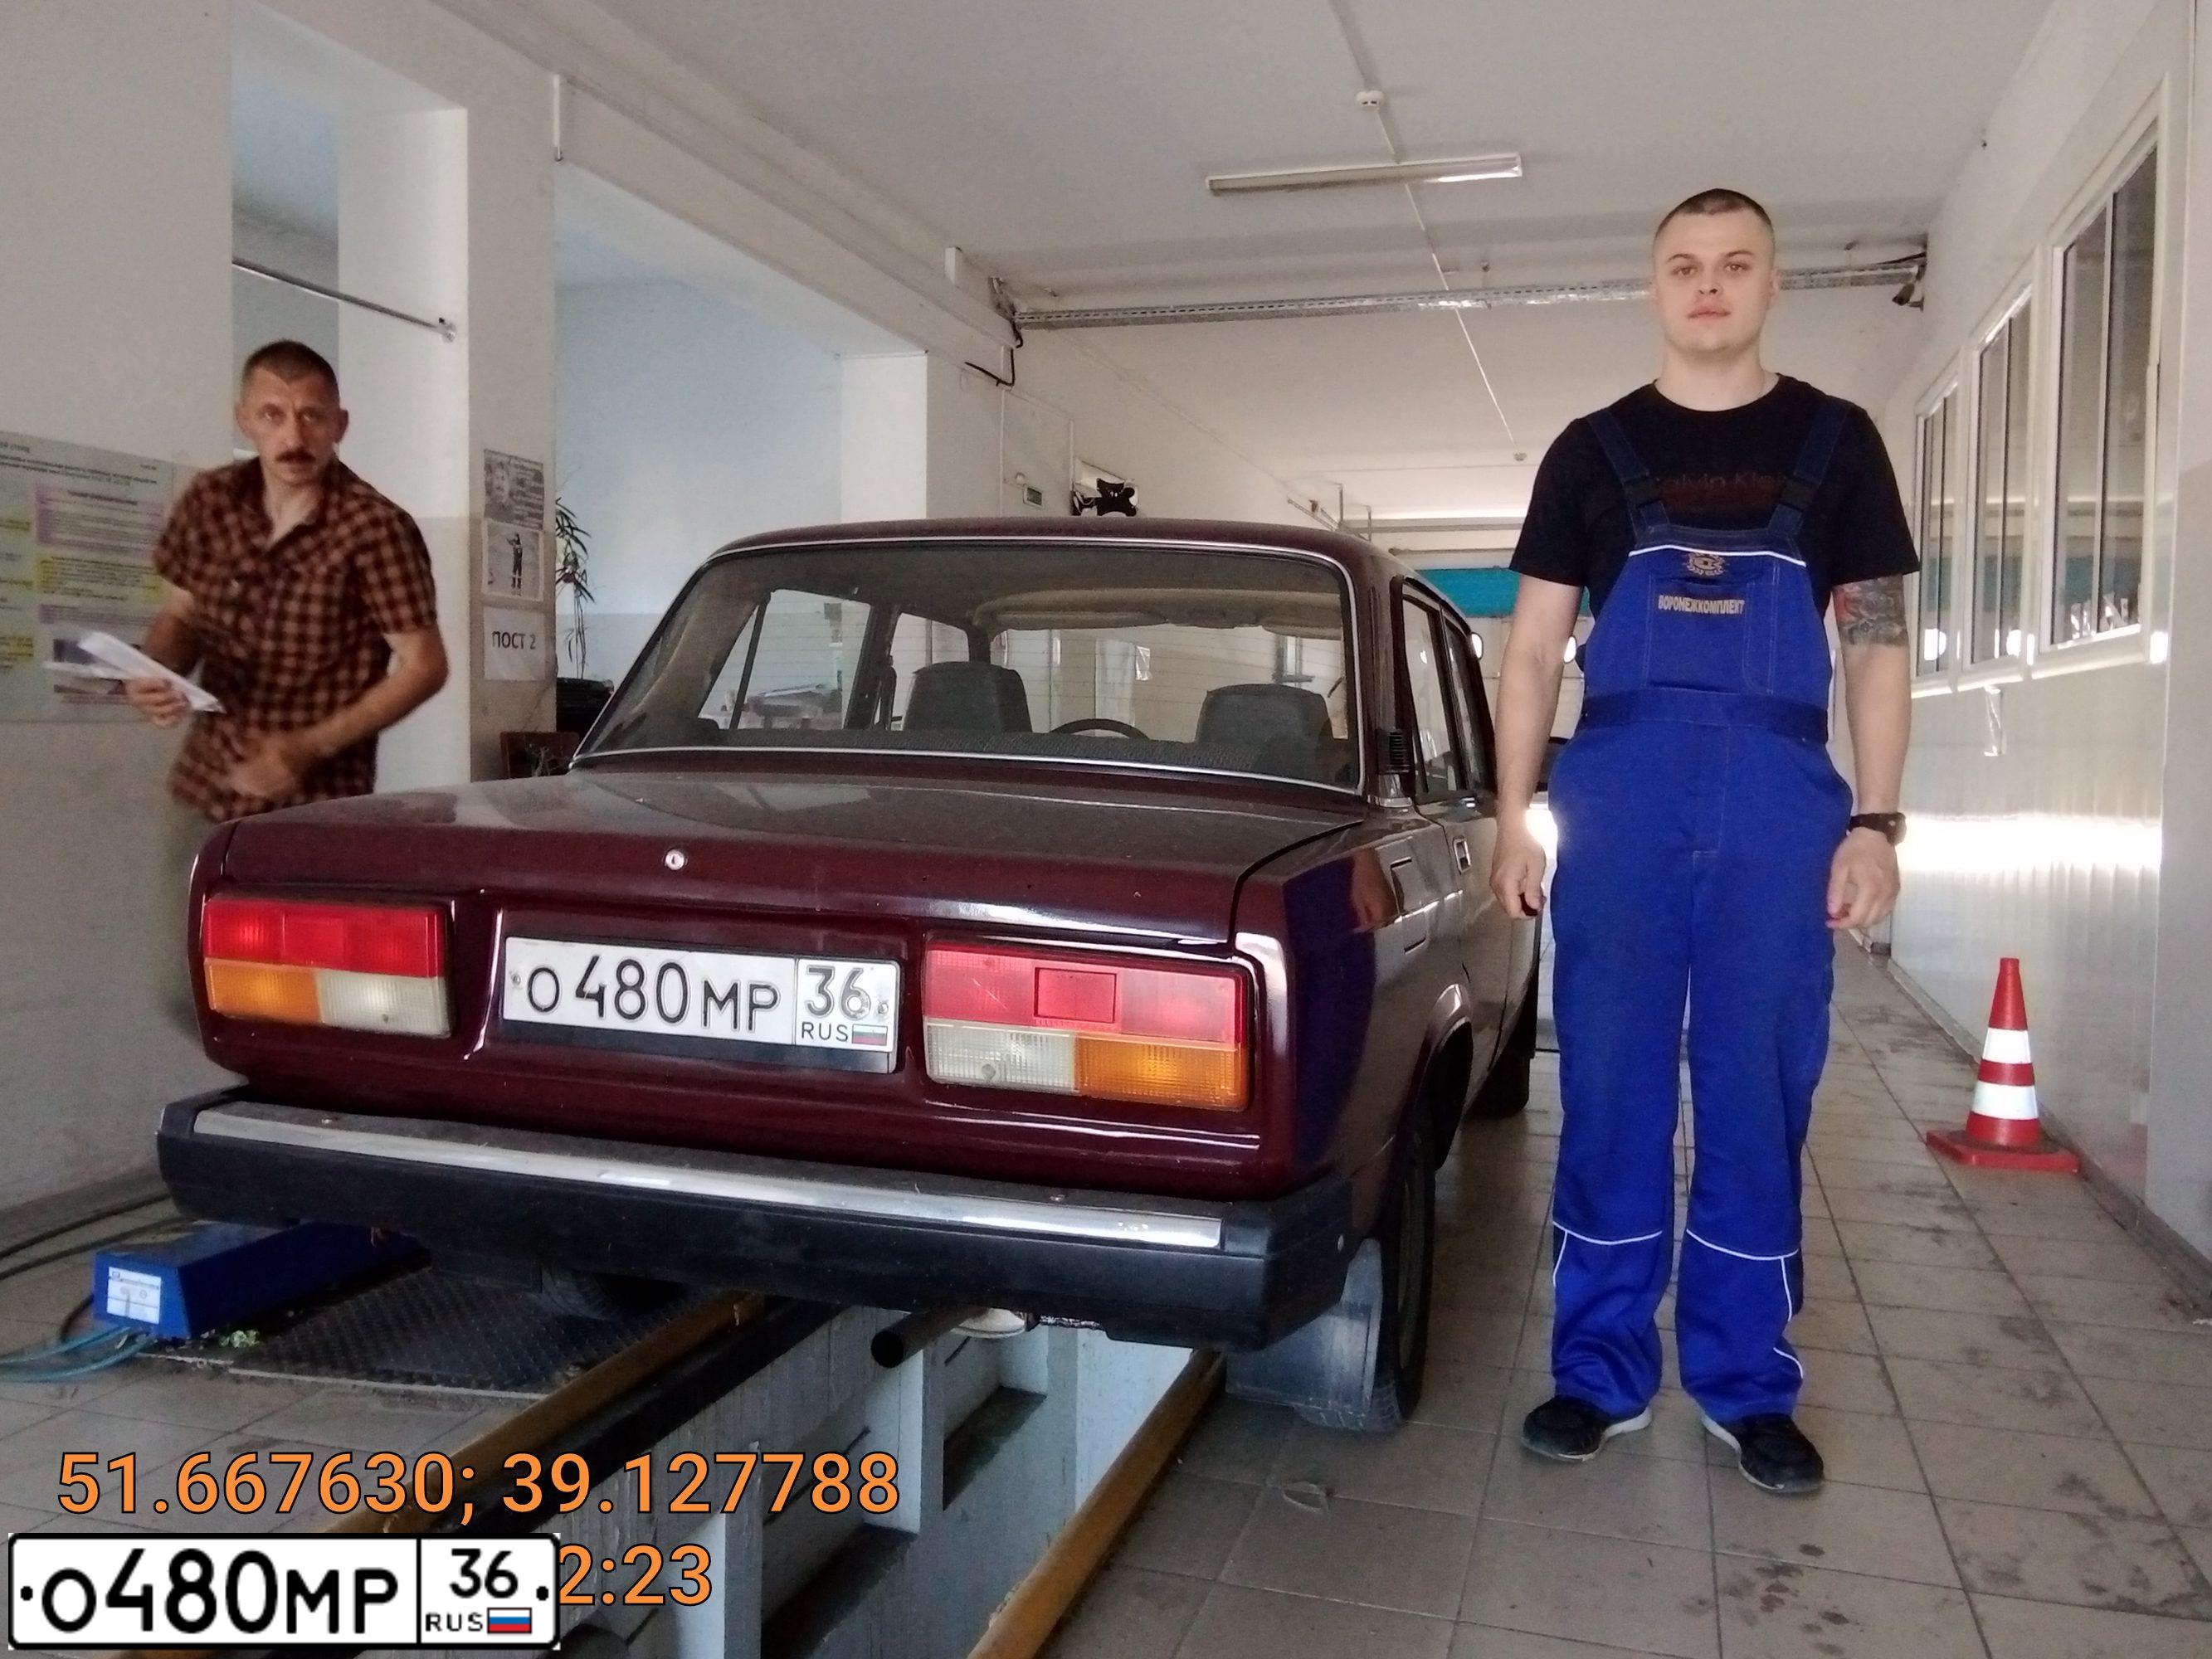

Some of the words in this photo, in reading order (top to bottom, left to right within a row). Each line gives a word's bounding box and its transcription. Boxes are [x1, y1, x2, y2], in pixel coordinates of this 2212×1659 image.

[491, 631, 525, 649] ПОСТ
[529, 633, 537, 649] 2
[806, 966, 871, 1021] 36
[801, 1021, 849, 1043] RUS
